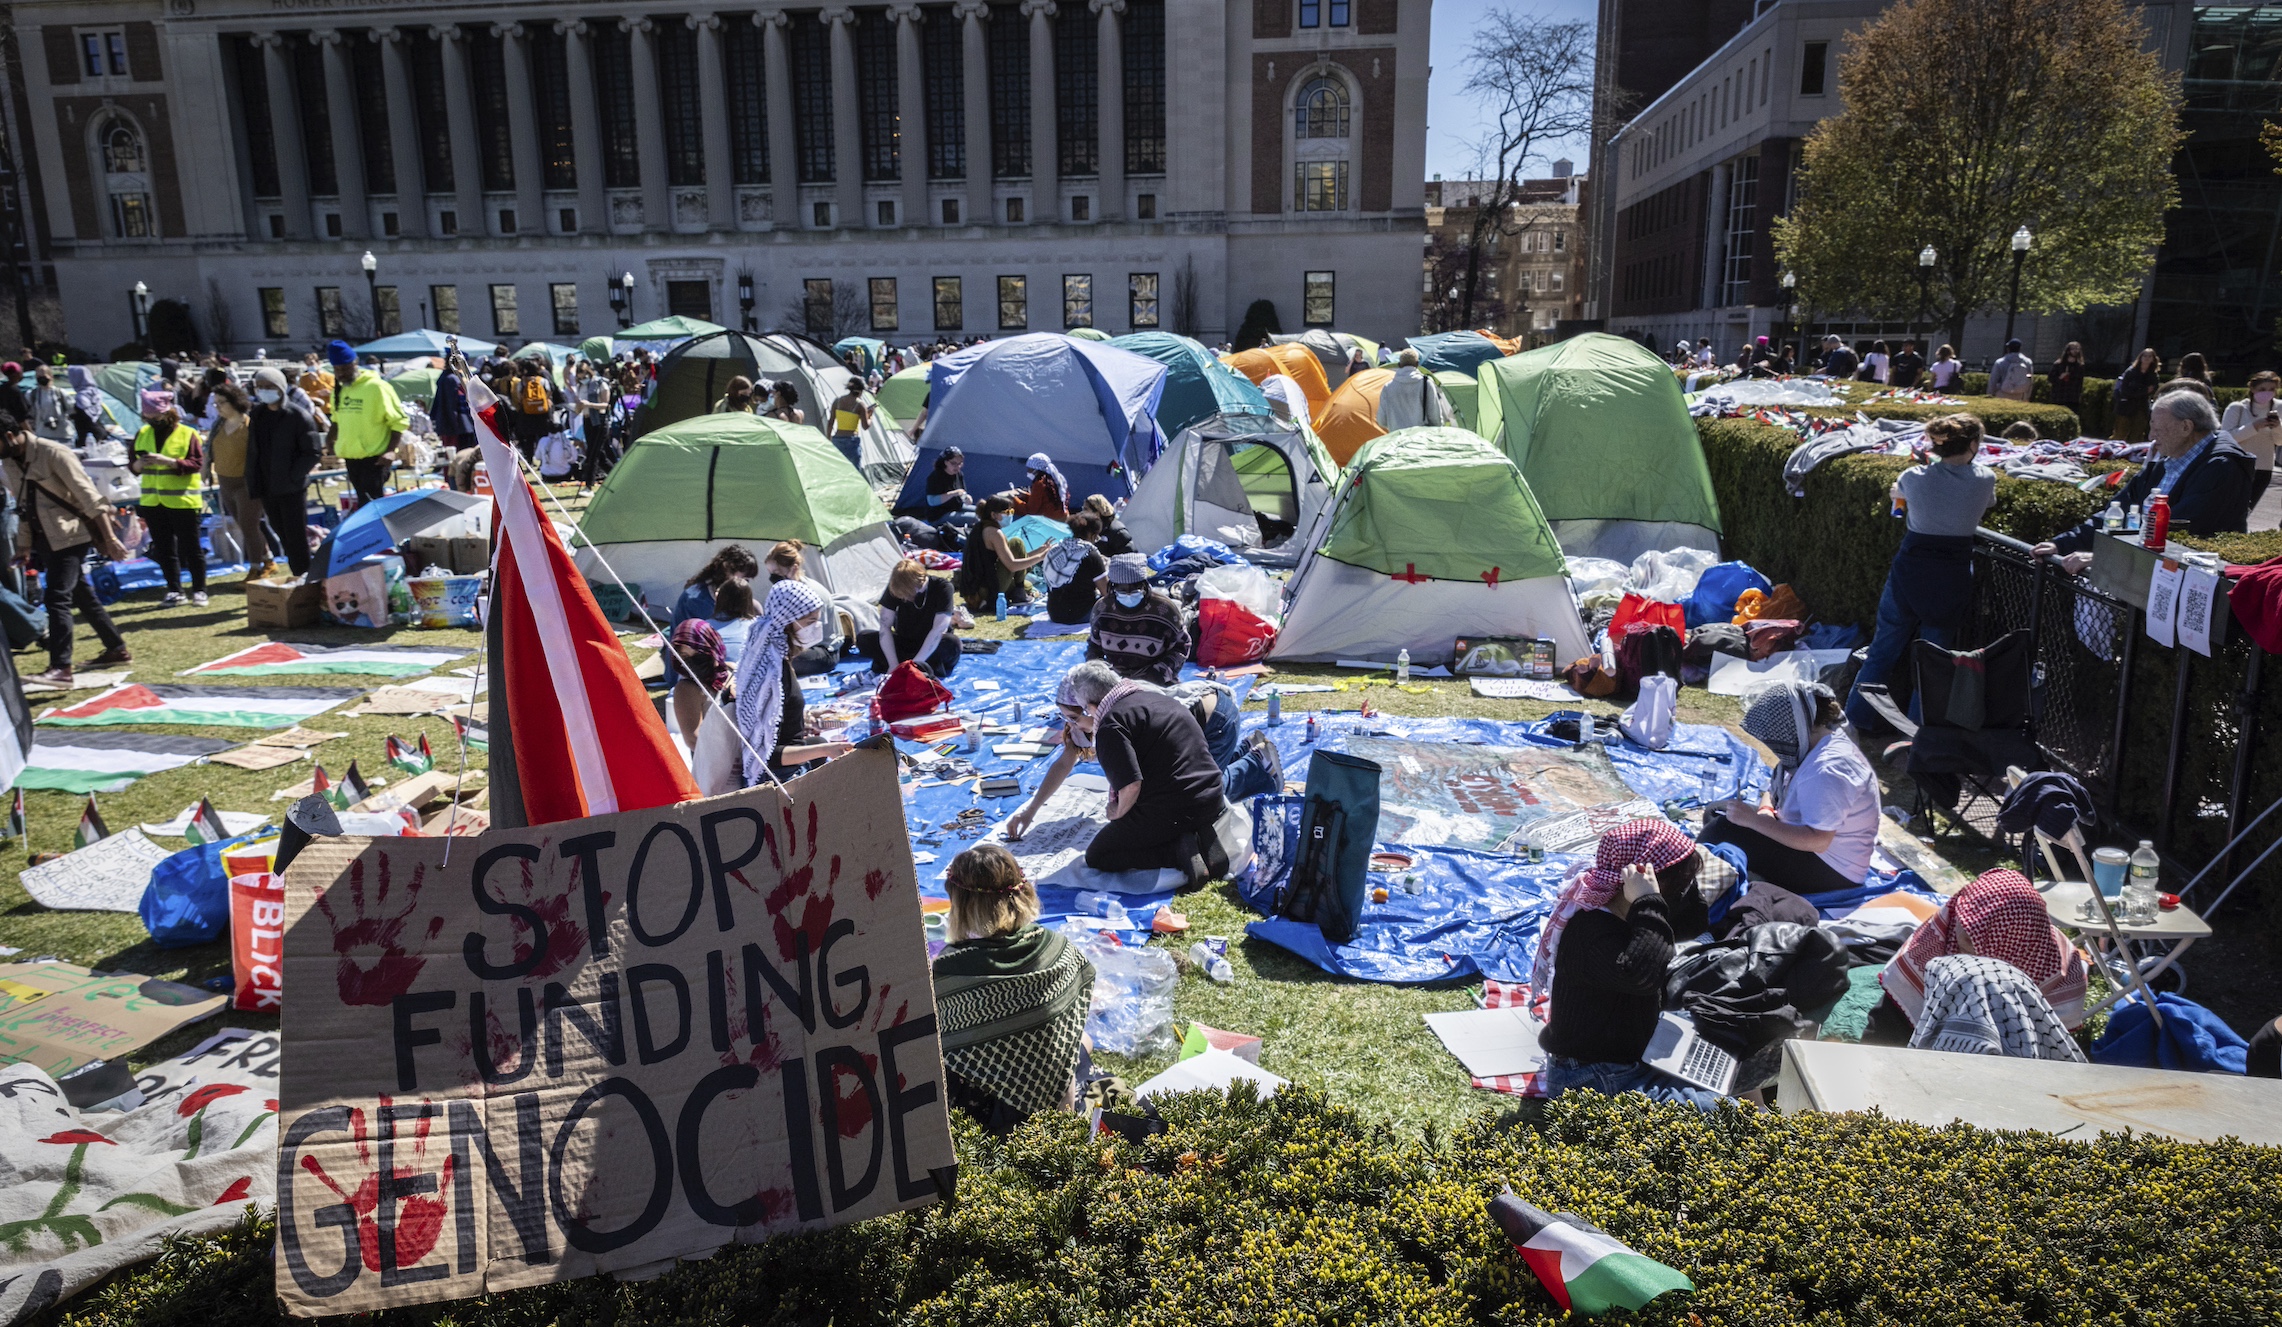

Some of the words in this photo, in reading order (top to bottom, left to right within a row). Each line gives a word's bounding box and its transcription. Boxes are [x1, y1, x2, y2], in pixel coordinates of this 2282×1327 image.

[251, 900, 284, 1009] BLICK
[463, 807, 765, 979] STOP
[391, 919, 869, 1090] FUNDING
[278, 1014, 938, 1297] GENOCIDE
